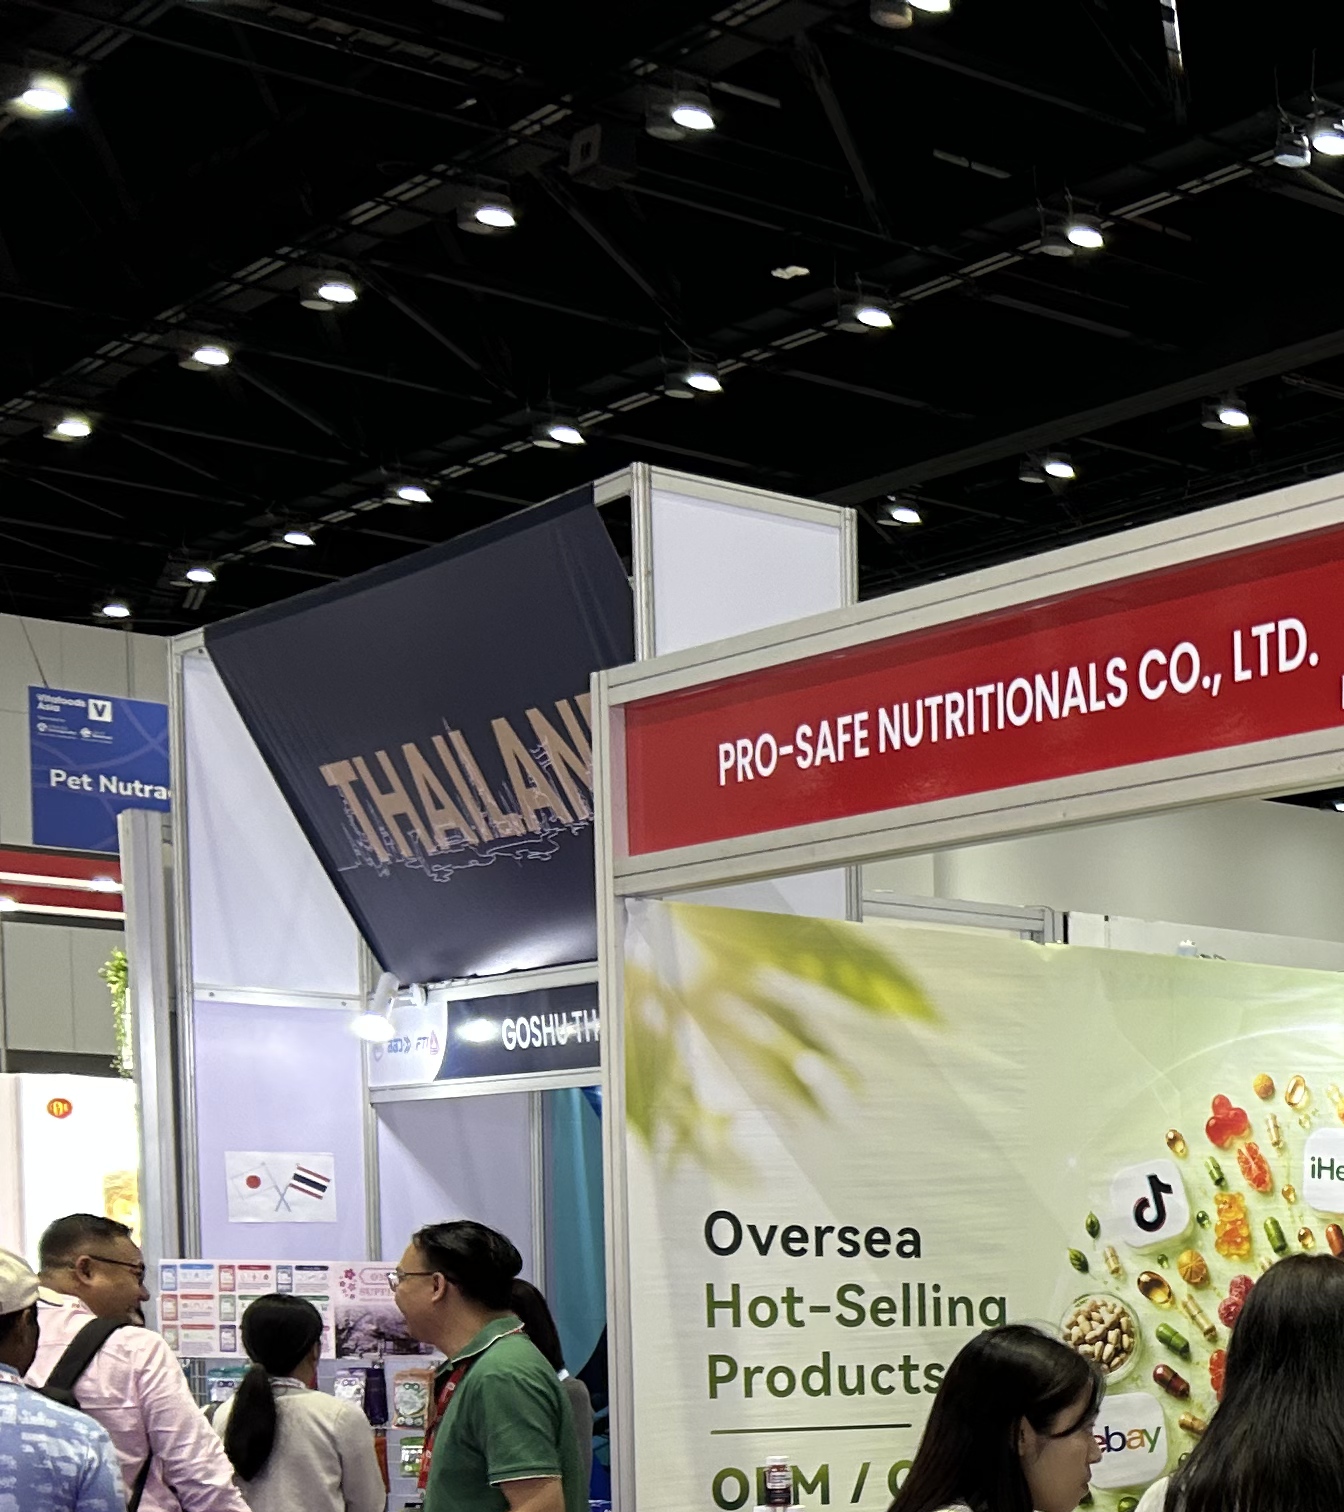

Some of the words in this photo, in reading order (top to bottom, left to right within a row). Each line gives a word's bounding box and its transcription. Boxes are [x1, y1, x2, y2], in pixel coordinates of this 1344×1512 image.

[718, 710, 870, 786] PRO-SAFE
[879, 657, 1127, 753] NUTRITIONALS
[1137, 641, 1223, 699] CO.,
[1233, 617, 1319, 684] LTD.
[50, 769, 93, 791] Pet
[99, 774, 171, 800] Nutra
[319, 692, 593, 864] THAILAN
[501, 1013, 568, 1051] GOSHU
[703, 1210, 922, 1259] Oversea
[704, 1282, 1007, 1328] Hot-Selling
[708, 1351, 944, 1400] Products
